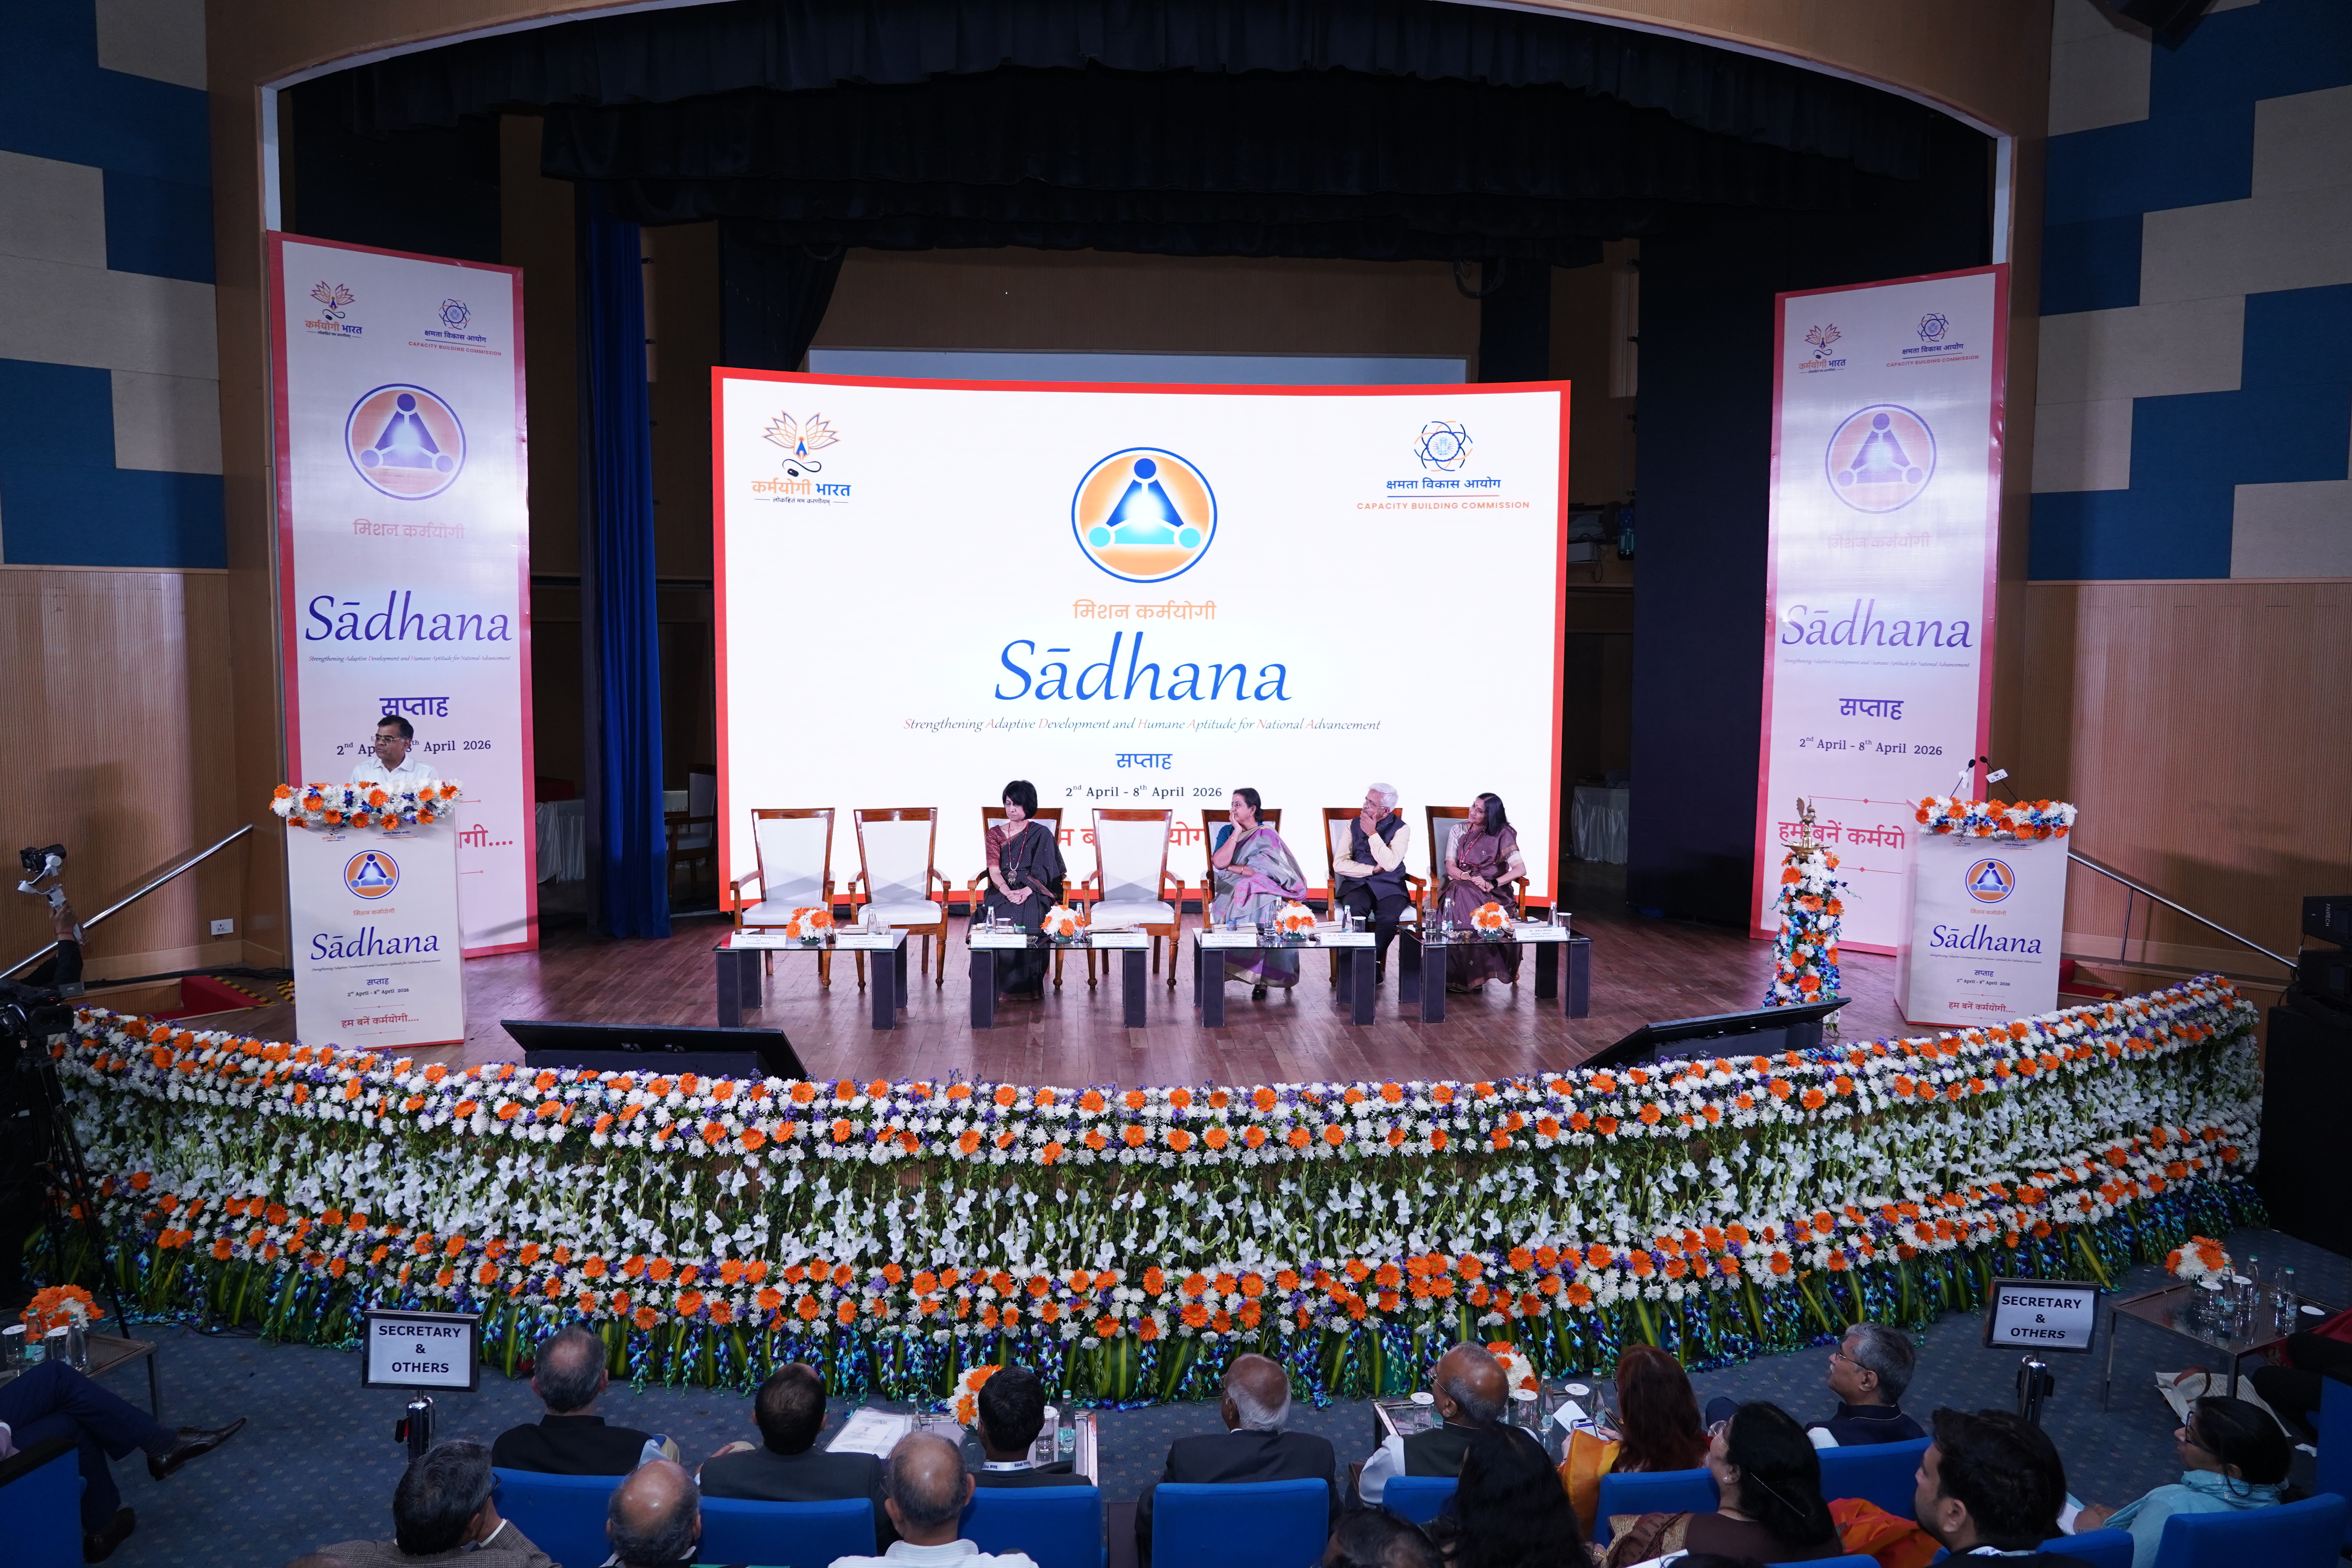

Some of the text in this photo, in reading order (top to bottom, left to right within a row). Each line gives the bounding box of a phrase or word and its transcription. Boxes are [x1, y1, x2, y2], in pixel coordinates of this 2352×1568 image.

[305, 320, 362, 334] कर्मयोगी भारत
[444, 331, 465, 340] विकास
[1798, 359, 1827, 370] कर्मयोगी
[751, 477, 851, 497] कर्मयोगी भारत
[1387, 476, 1501, 490] क्षमता विकास आयोग
[353, 518, 465, 539] मिशन कर्मयोगी
[305, 590, 512, 641] Sādhana
[1073, 599, 1217, 620] मिशन कर्मयोगी
[1782, 599, 1973, 648] Sādhana
[995, 631, 1292, 701] Sādhana
[379, 697, 449, 717] सप्ताह
[1839, 698, 1904, 720] सप्ताह
[904, 717, 1381, 733] Strengthening Adaptive Development and Humane Aptitude for National Advancement
[337, 742, 354, 755] 2nd
[423, 740, 456, 755] April
[463, 740, 491, 751] 2026
[1800, 736, 1814, 748] 2nd
[1817, 739, 1846, 751] April
[1859, 739, 1872, 751] 8th
[1875, 742, 1906, 754] April
[1914, 745, 1942, 755] 2026
[1116, 753, 1173, 769] सप्ताह
[1065, 785, 1082, 797] 2nd
[1086, 787, 1119, 799] April
[1133, 785, 1147, 797] 8th
[1152, 787, 1185, 799] April
[1193, 788, 1222, 797] 2026
[1778, 820, 1904, 849] हम बनें कर्मयो
[311, 926, 440, 960] Sādhana
[1930, 924, 2042, 954] Sādhana
[1962, 1001, 1973, 1009] बनें
[341, 1019, 354, 1028] हम
[356, 1016, 370, 1025] बनें
[2002, 1296, 2082, 1309] SECRETARY
[2035, 1314, 2045, 1323] &
[379, 1325, 461, 1338] SECRETARY
[2011, 1328, 2065, 1339] OTHERS
[416, 1344, 426, 1354] &
[392, 1362, 449, 1373] OTHERS
